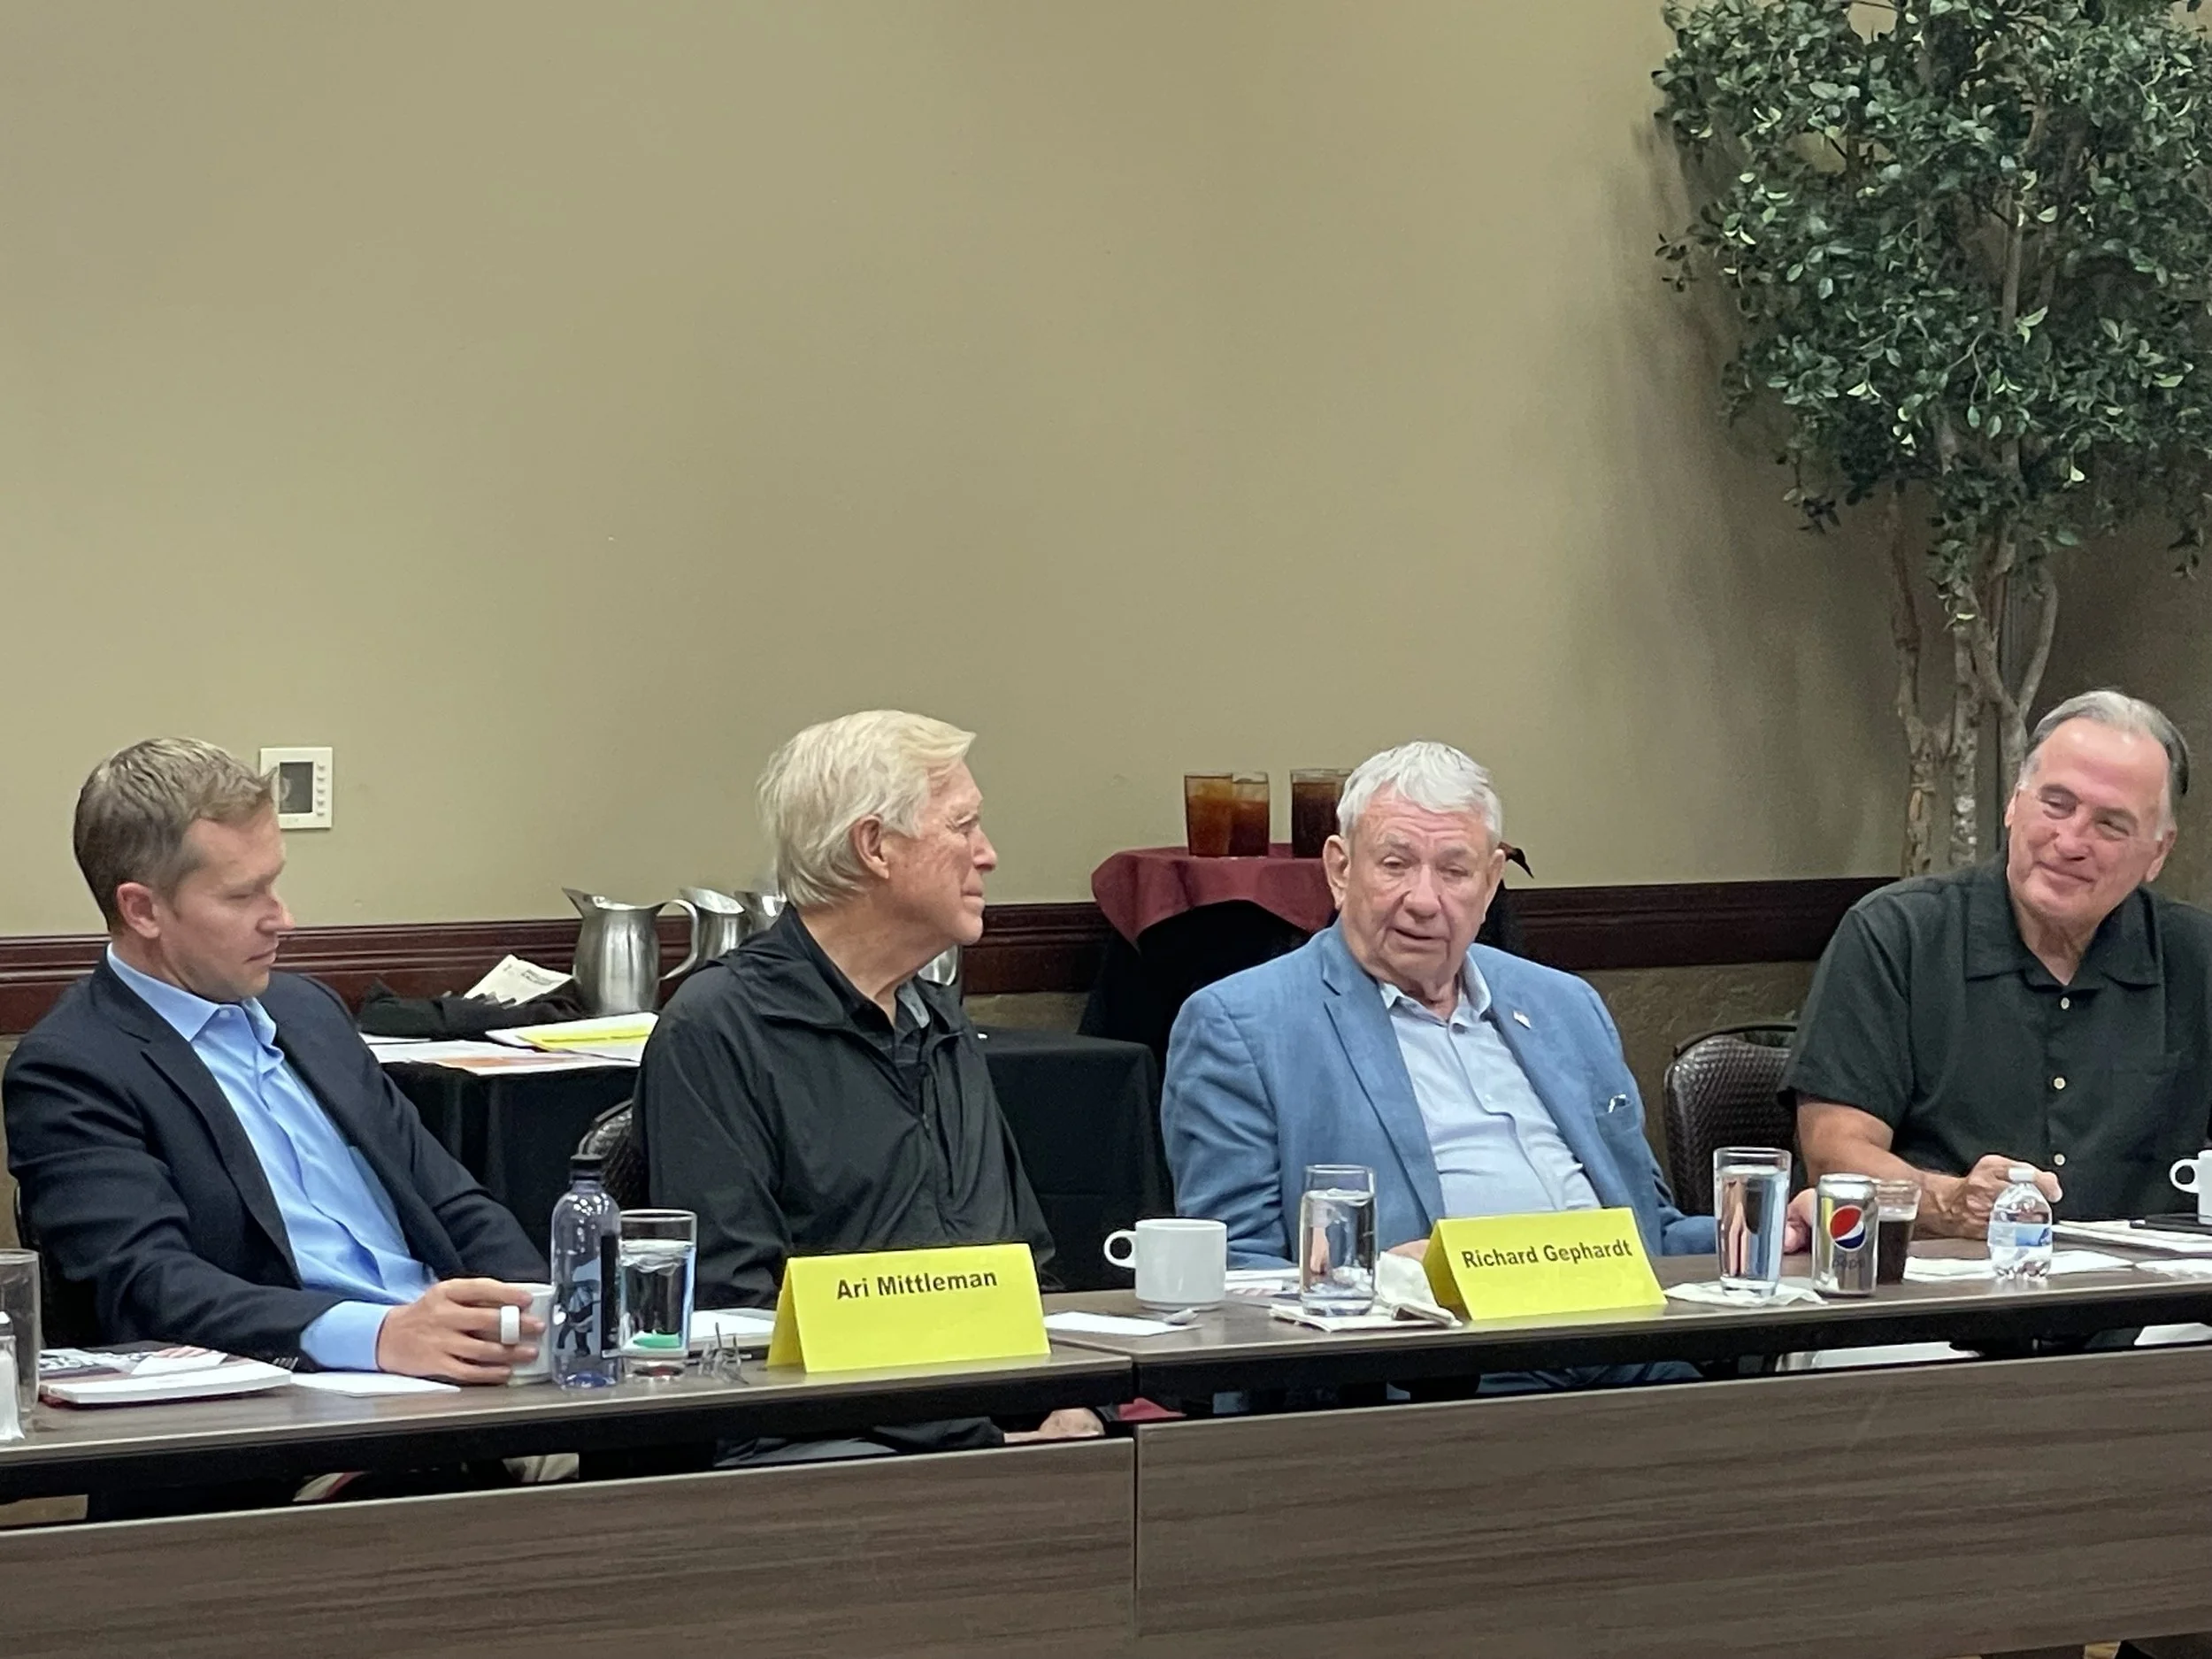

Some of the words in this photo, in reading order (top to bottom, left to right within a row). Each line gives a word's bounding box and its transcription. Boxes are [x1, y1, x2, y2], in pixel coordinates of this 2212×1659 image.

[1462, 1246, 1539, 1269] Richard
[1543, 1239, 1633, 1263] Gephardt
[837, 1278, 870, 1300] Ari
[878, 1271, 997, 1296] Mittleman
